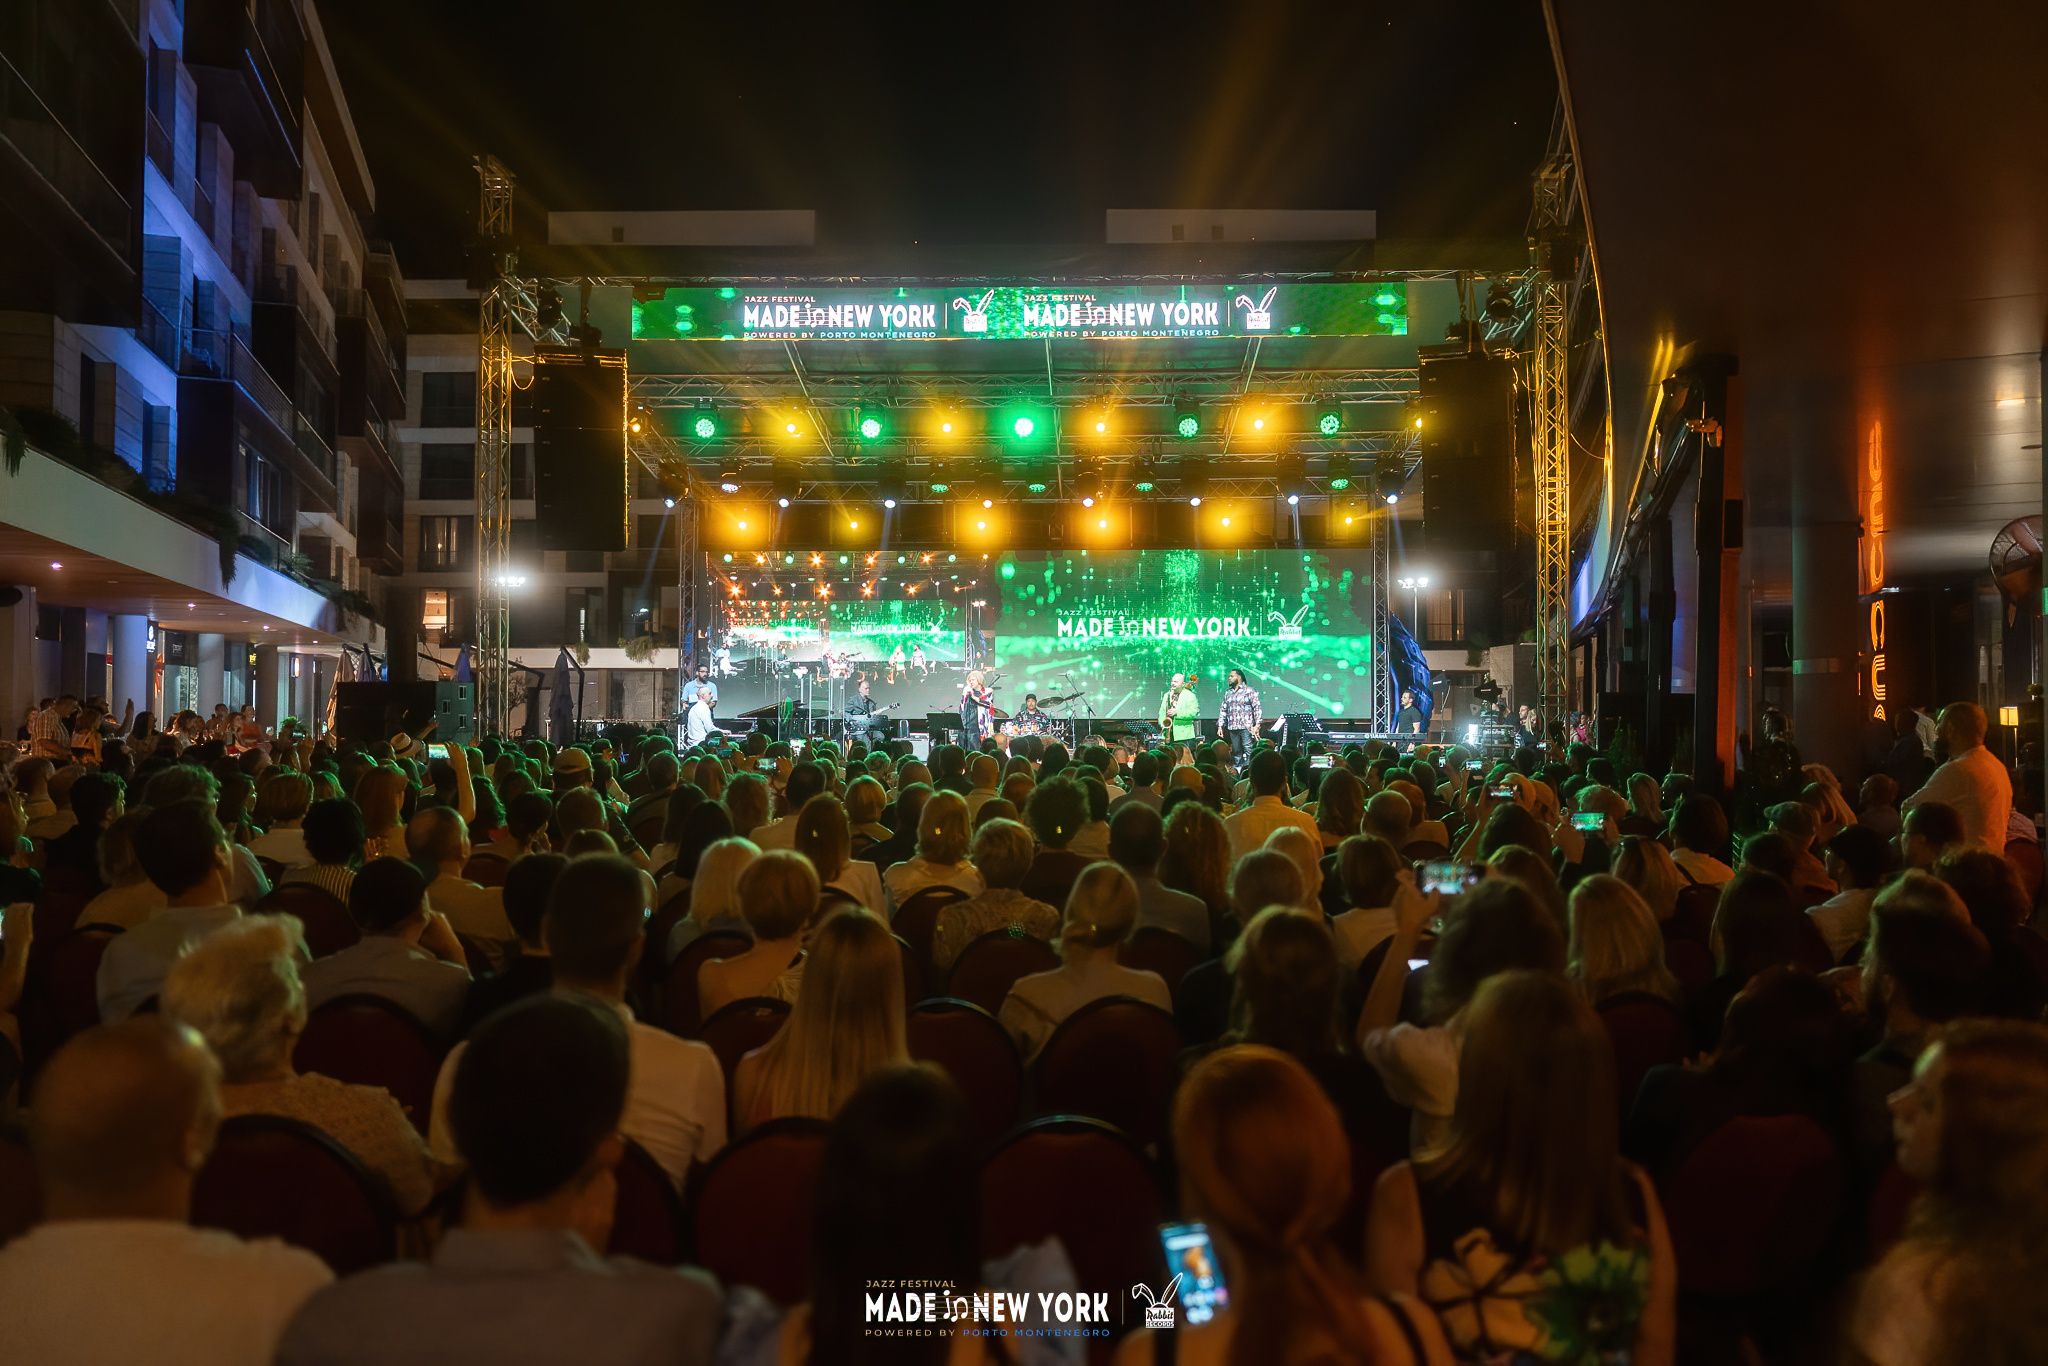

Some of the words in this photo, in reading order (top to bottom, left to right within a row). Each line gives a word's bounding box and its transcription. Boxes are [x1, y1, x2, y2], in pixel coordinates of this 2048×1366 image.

[744, 295, 769, 303] JAZZ
[771, 295, 816, 303] FESTIVAL
[1024, 294, 1048, 302] JAZZ
[1051, 294, 1097, 302] FESTIVAL
[743, 304, 801, 328] MADE
[828, 304, 874, 328] NEW
[878, 304, 936, 328] YORK
[1023, 303, 1081, 327] MADE
[1110, 303, 1156, 327] NEW
[1161, 302, 1219, 326] YORK
[820, 331, 857, 339] PORTO
[860, 331, 936, 339] MONTENEGRO
[1101, 330, 1138, 338] PORTO
[1142, 329, 1219, 337] MONTENEGRO
[1057, 617, 1114, 638] MADE
[1142, 617, 1188, 638] NEW
[1193, 617, 1251, 637] YORK
